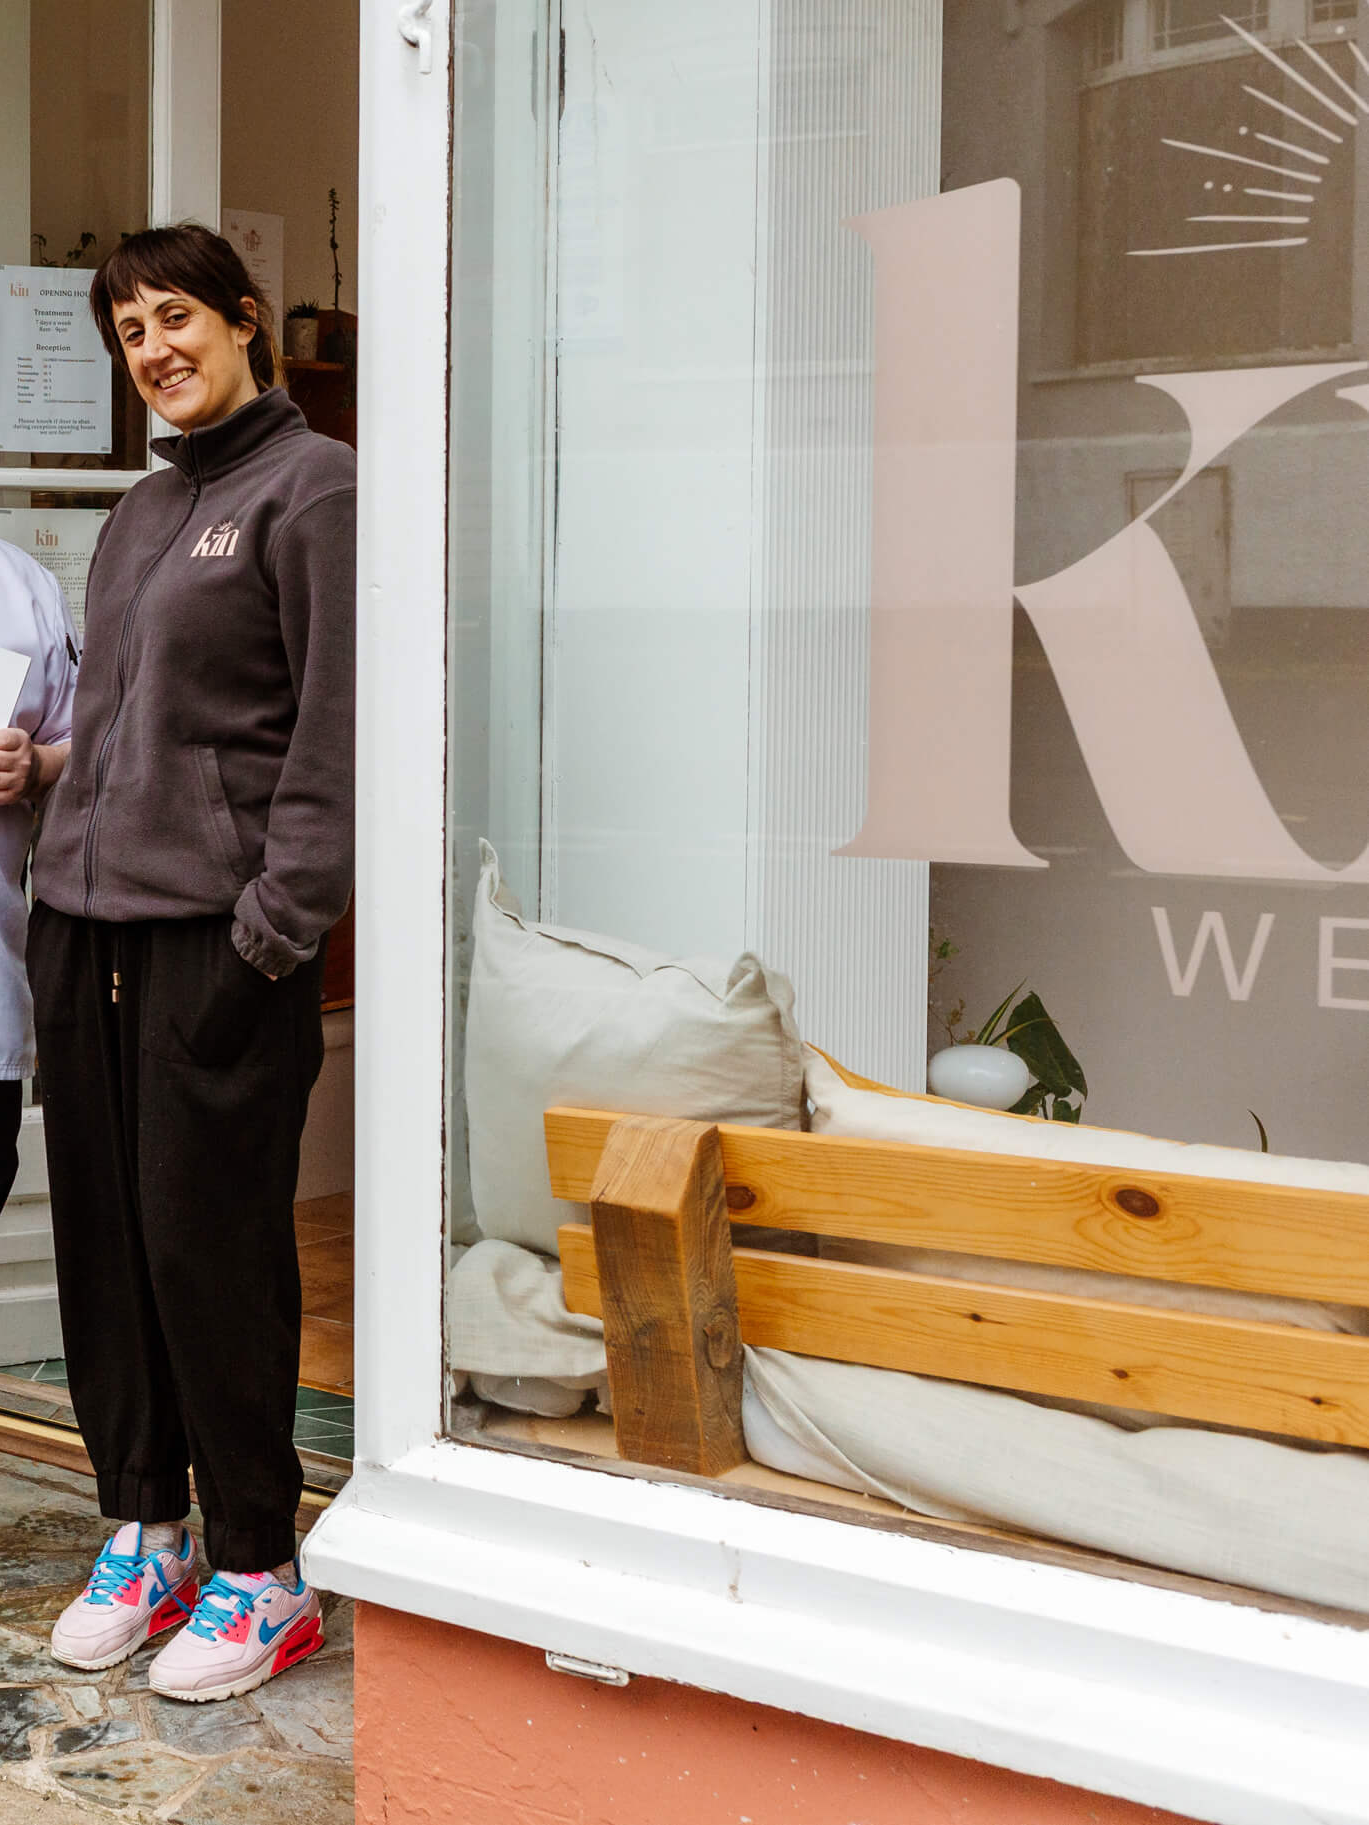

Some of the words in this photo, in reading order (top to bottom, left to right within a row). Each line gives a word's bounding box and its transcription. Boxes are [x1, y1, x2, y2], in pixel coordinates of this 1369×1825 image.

[10, 281, 29, 297] kin
[39, 289, 72, 298] OPENING
[33, 308, 74, 317] Treatments
[36, 344, 71, 352] Reception
[35, 528, 59, 546] kin
[831, 176, 1369, 883] k
[190, 522, 240, 557] kin
[1150, 906, 1369, 1011] WE
